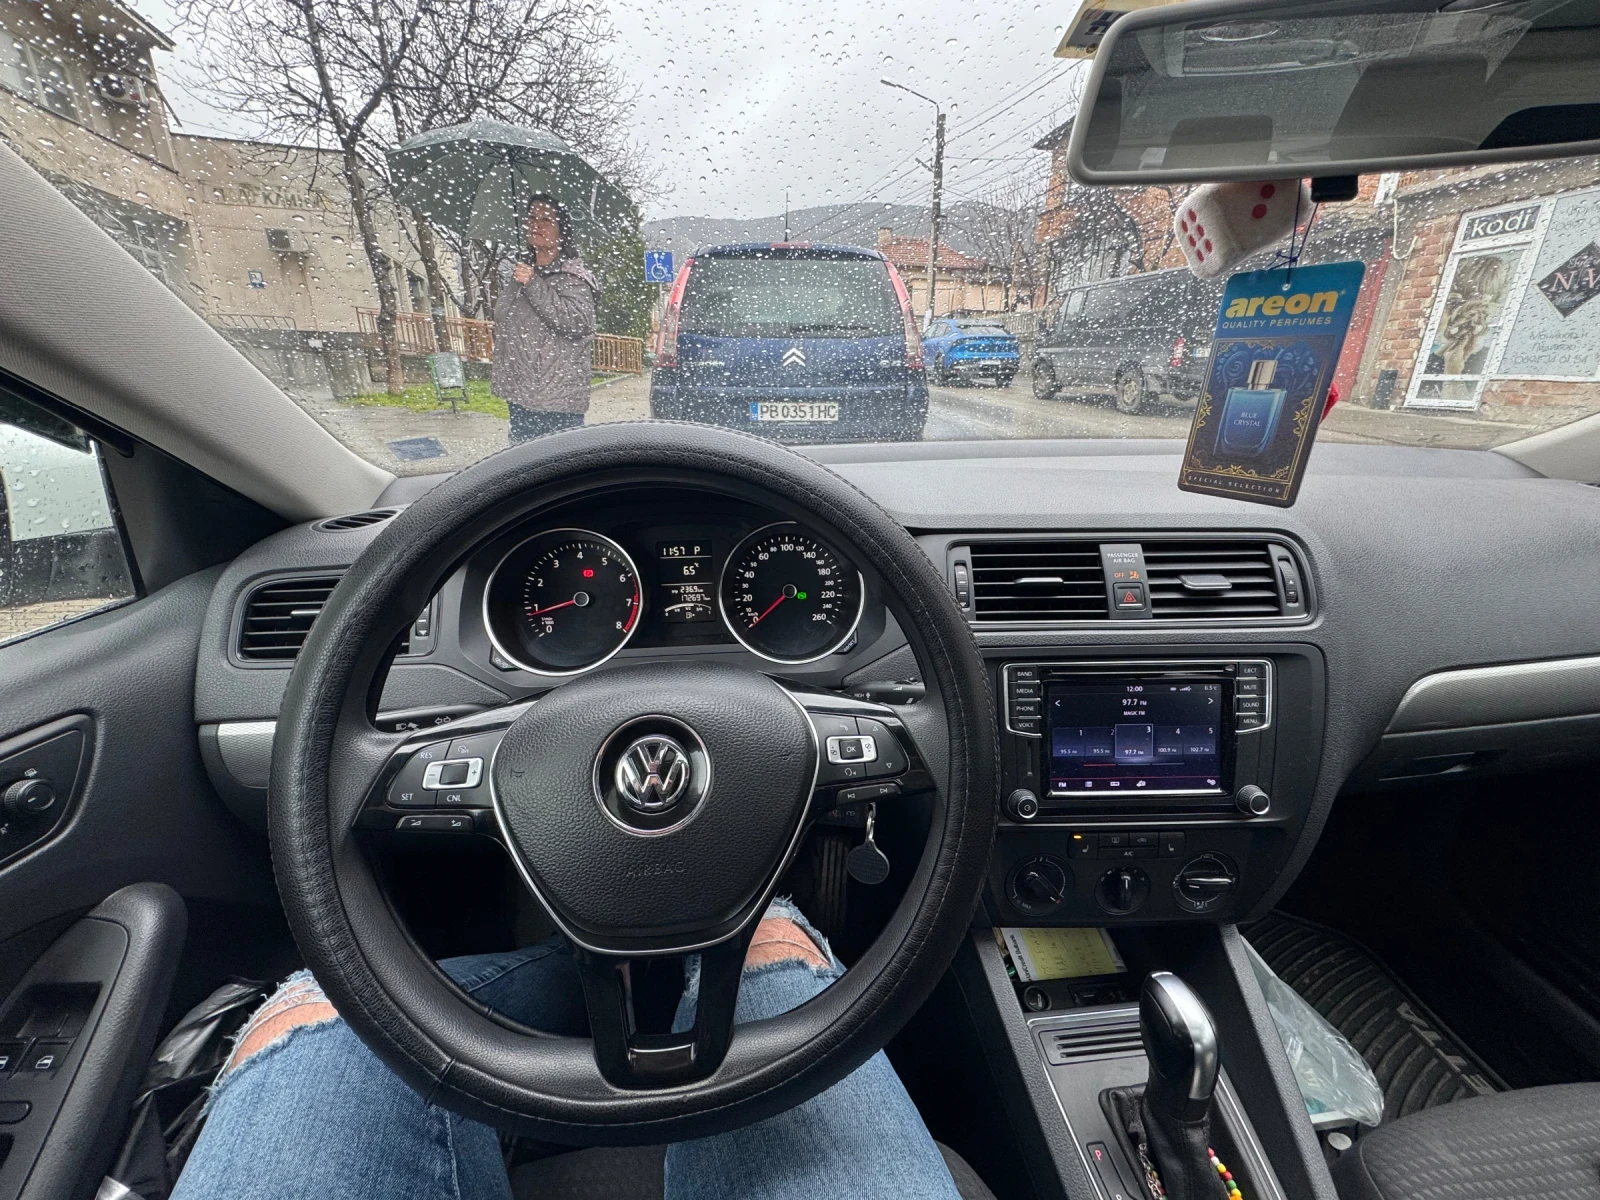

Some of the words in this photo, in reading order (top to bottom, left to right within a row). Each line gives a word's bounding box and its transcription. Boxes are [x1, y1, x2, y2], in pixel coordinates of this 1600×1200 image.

[1471, 209, 1533, 238] kodi
[1225, 290, 1339, 318] areon
[1222, 320, 1266, 329] QUALITY
[1269, 316, 1332, 327] PERFUMES
[1241, 411, 1258, 419] BLUE
[1233, 419, 1260, 427] CRYSTAL
[1188, 475, 1222, 485] SPECIAL
[1228, 481, 1280, 493] SELECTION
[663, 546, 685, 556] 11:57
[694, 546, 700, 555] P
[802, 551, 816, 559] 140
[758, 552, 769, 560] 60
[553, 560, 560, 568] 3
[817, 568, 831, 576] 180
[619, 574, 626, 582] 6
[537, 579, 544, 587] 2
[742, 594, 752, 602] 20
[821, 591, 835, 599] 220
[625, 598, 632, 607] 7
[533, 603, 539, 611] 1
[812, 613, 827, 621] 260
[546, 625, 553, 633] 0
[616, 621, 622, 629] 8
[1122, 698, 1138, 706] 97.7
[846, 745, 856, 753] OK
[401, 793, 413, 801] SET
[625, 861, 685, 877] AIRBAG
[1095, 1150, 1101, 1160] P
